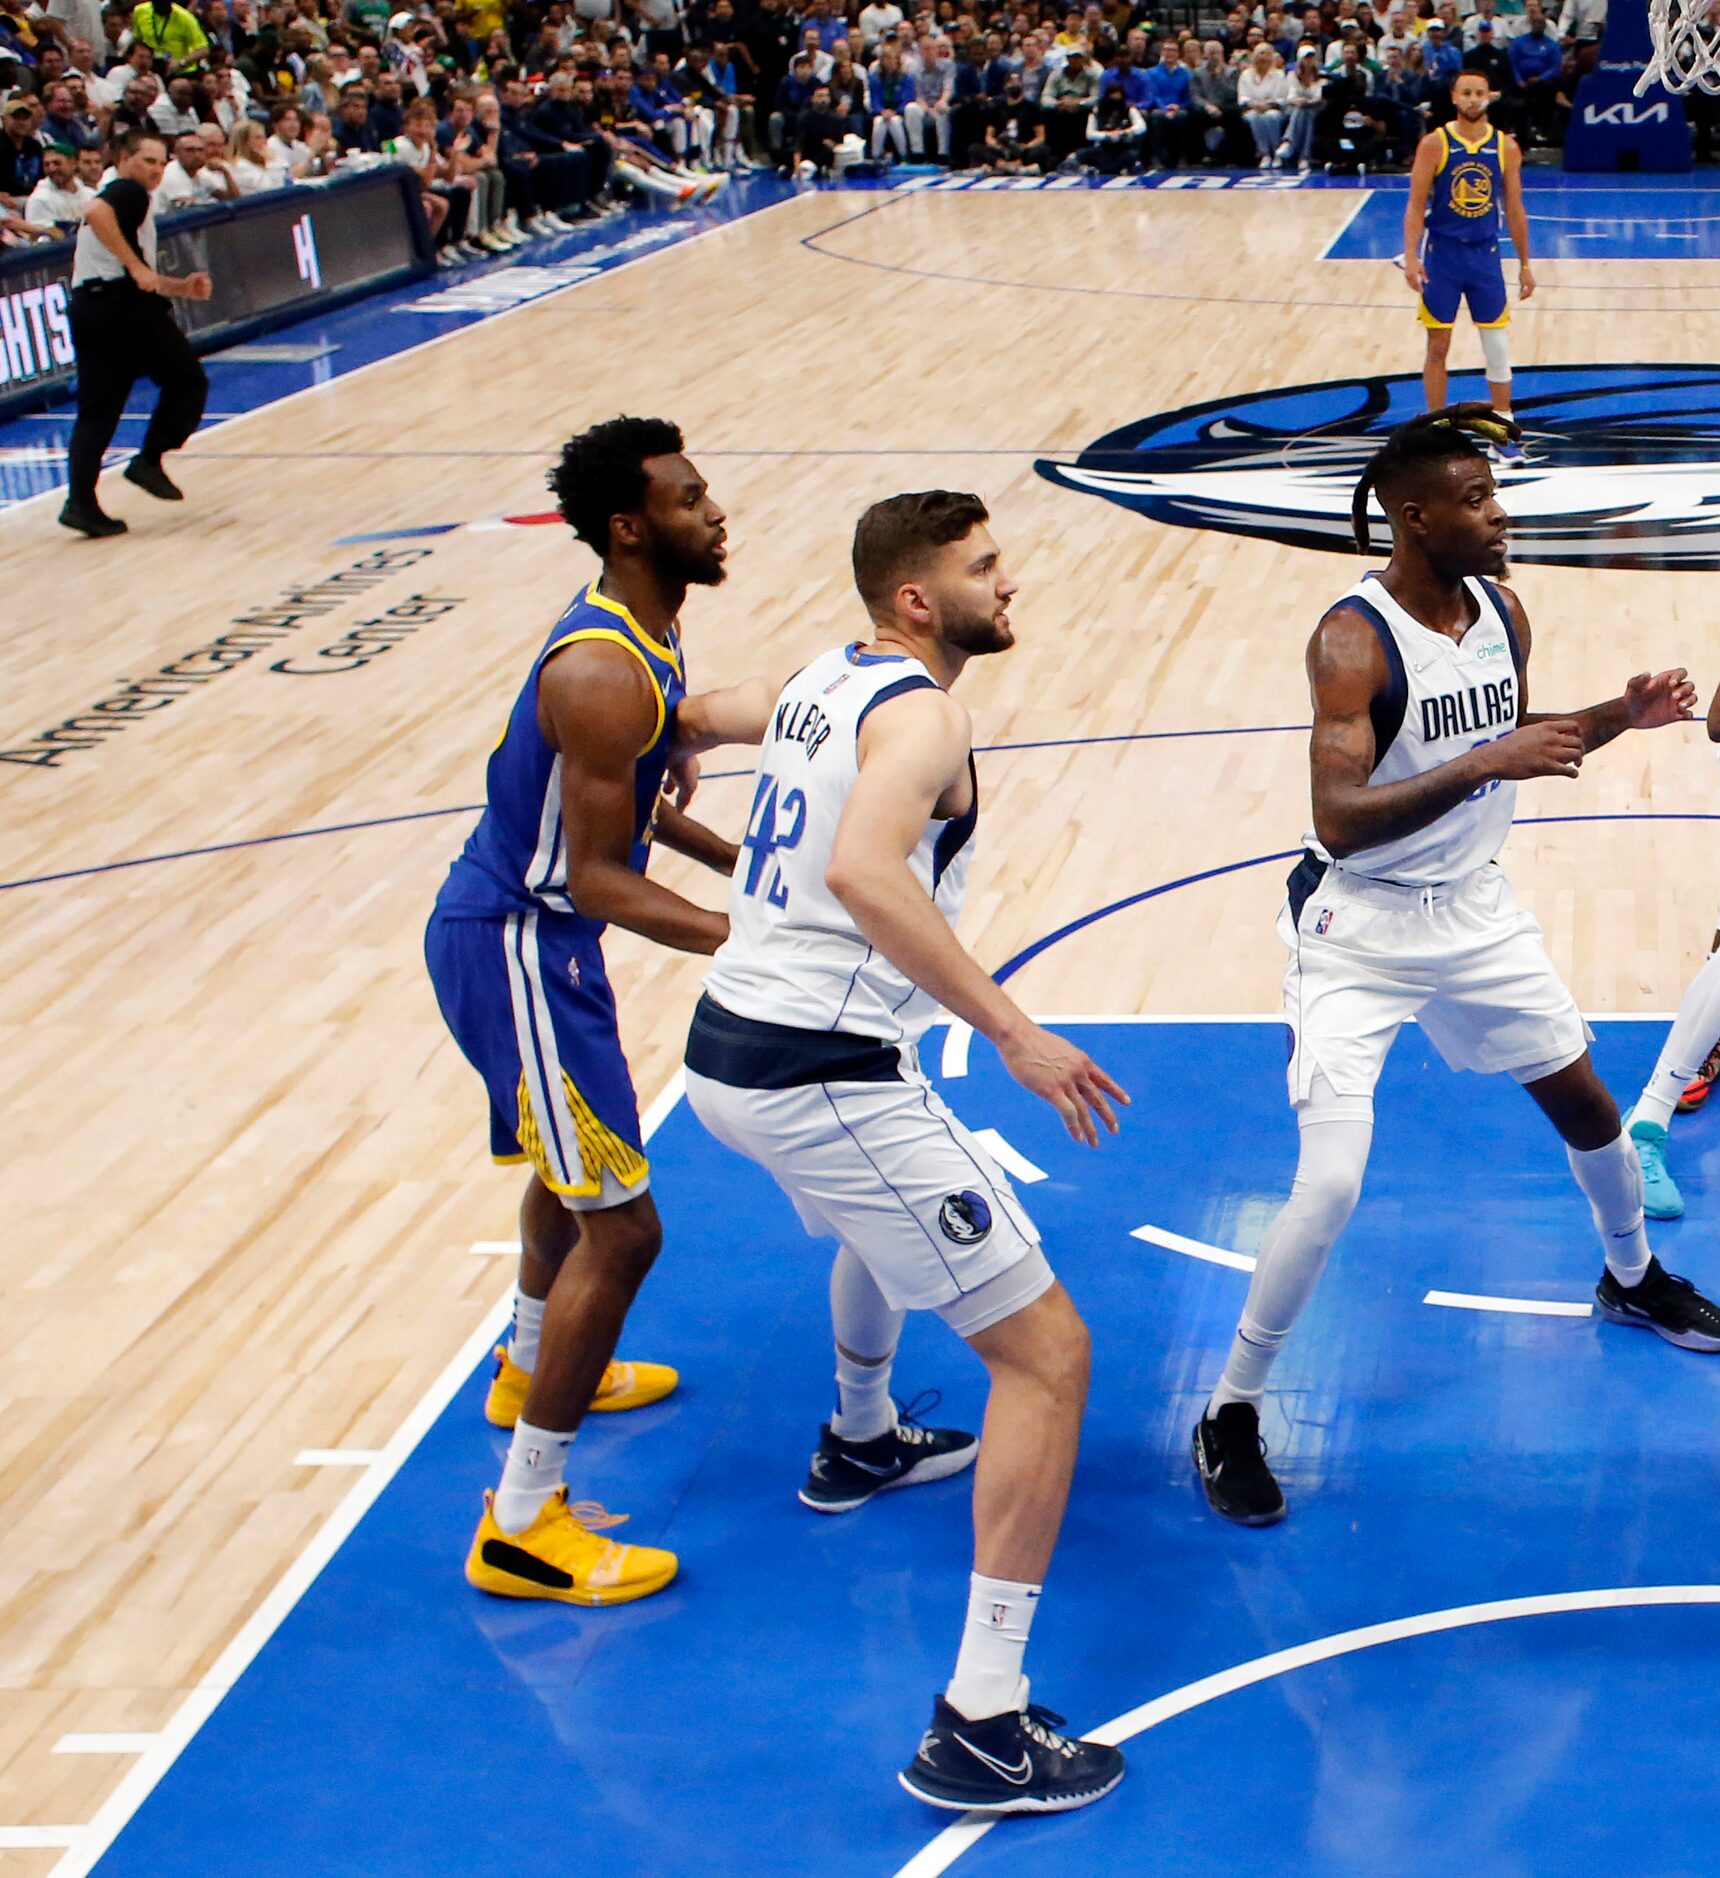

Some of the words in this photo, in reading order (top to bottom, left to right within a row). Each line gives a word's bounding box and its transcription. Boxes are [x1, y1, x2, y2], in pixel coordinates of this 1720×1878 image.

[0, 282, 77, 384] HTS
[270, 591, 468, 675] Center
[1477, 641, 1507, 660] chime
[1420, 677, 1516, 743] DALLAS
[741, 772, 807, 911] 42
